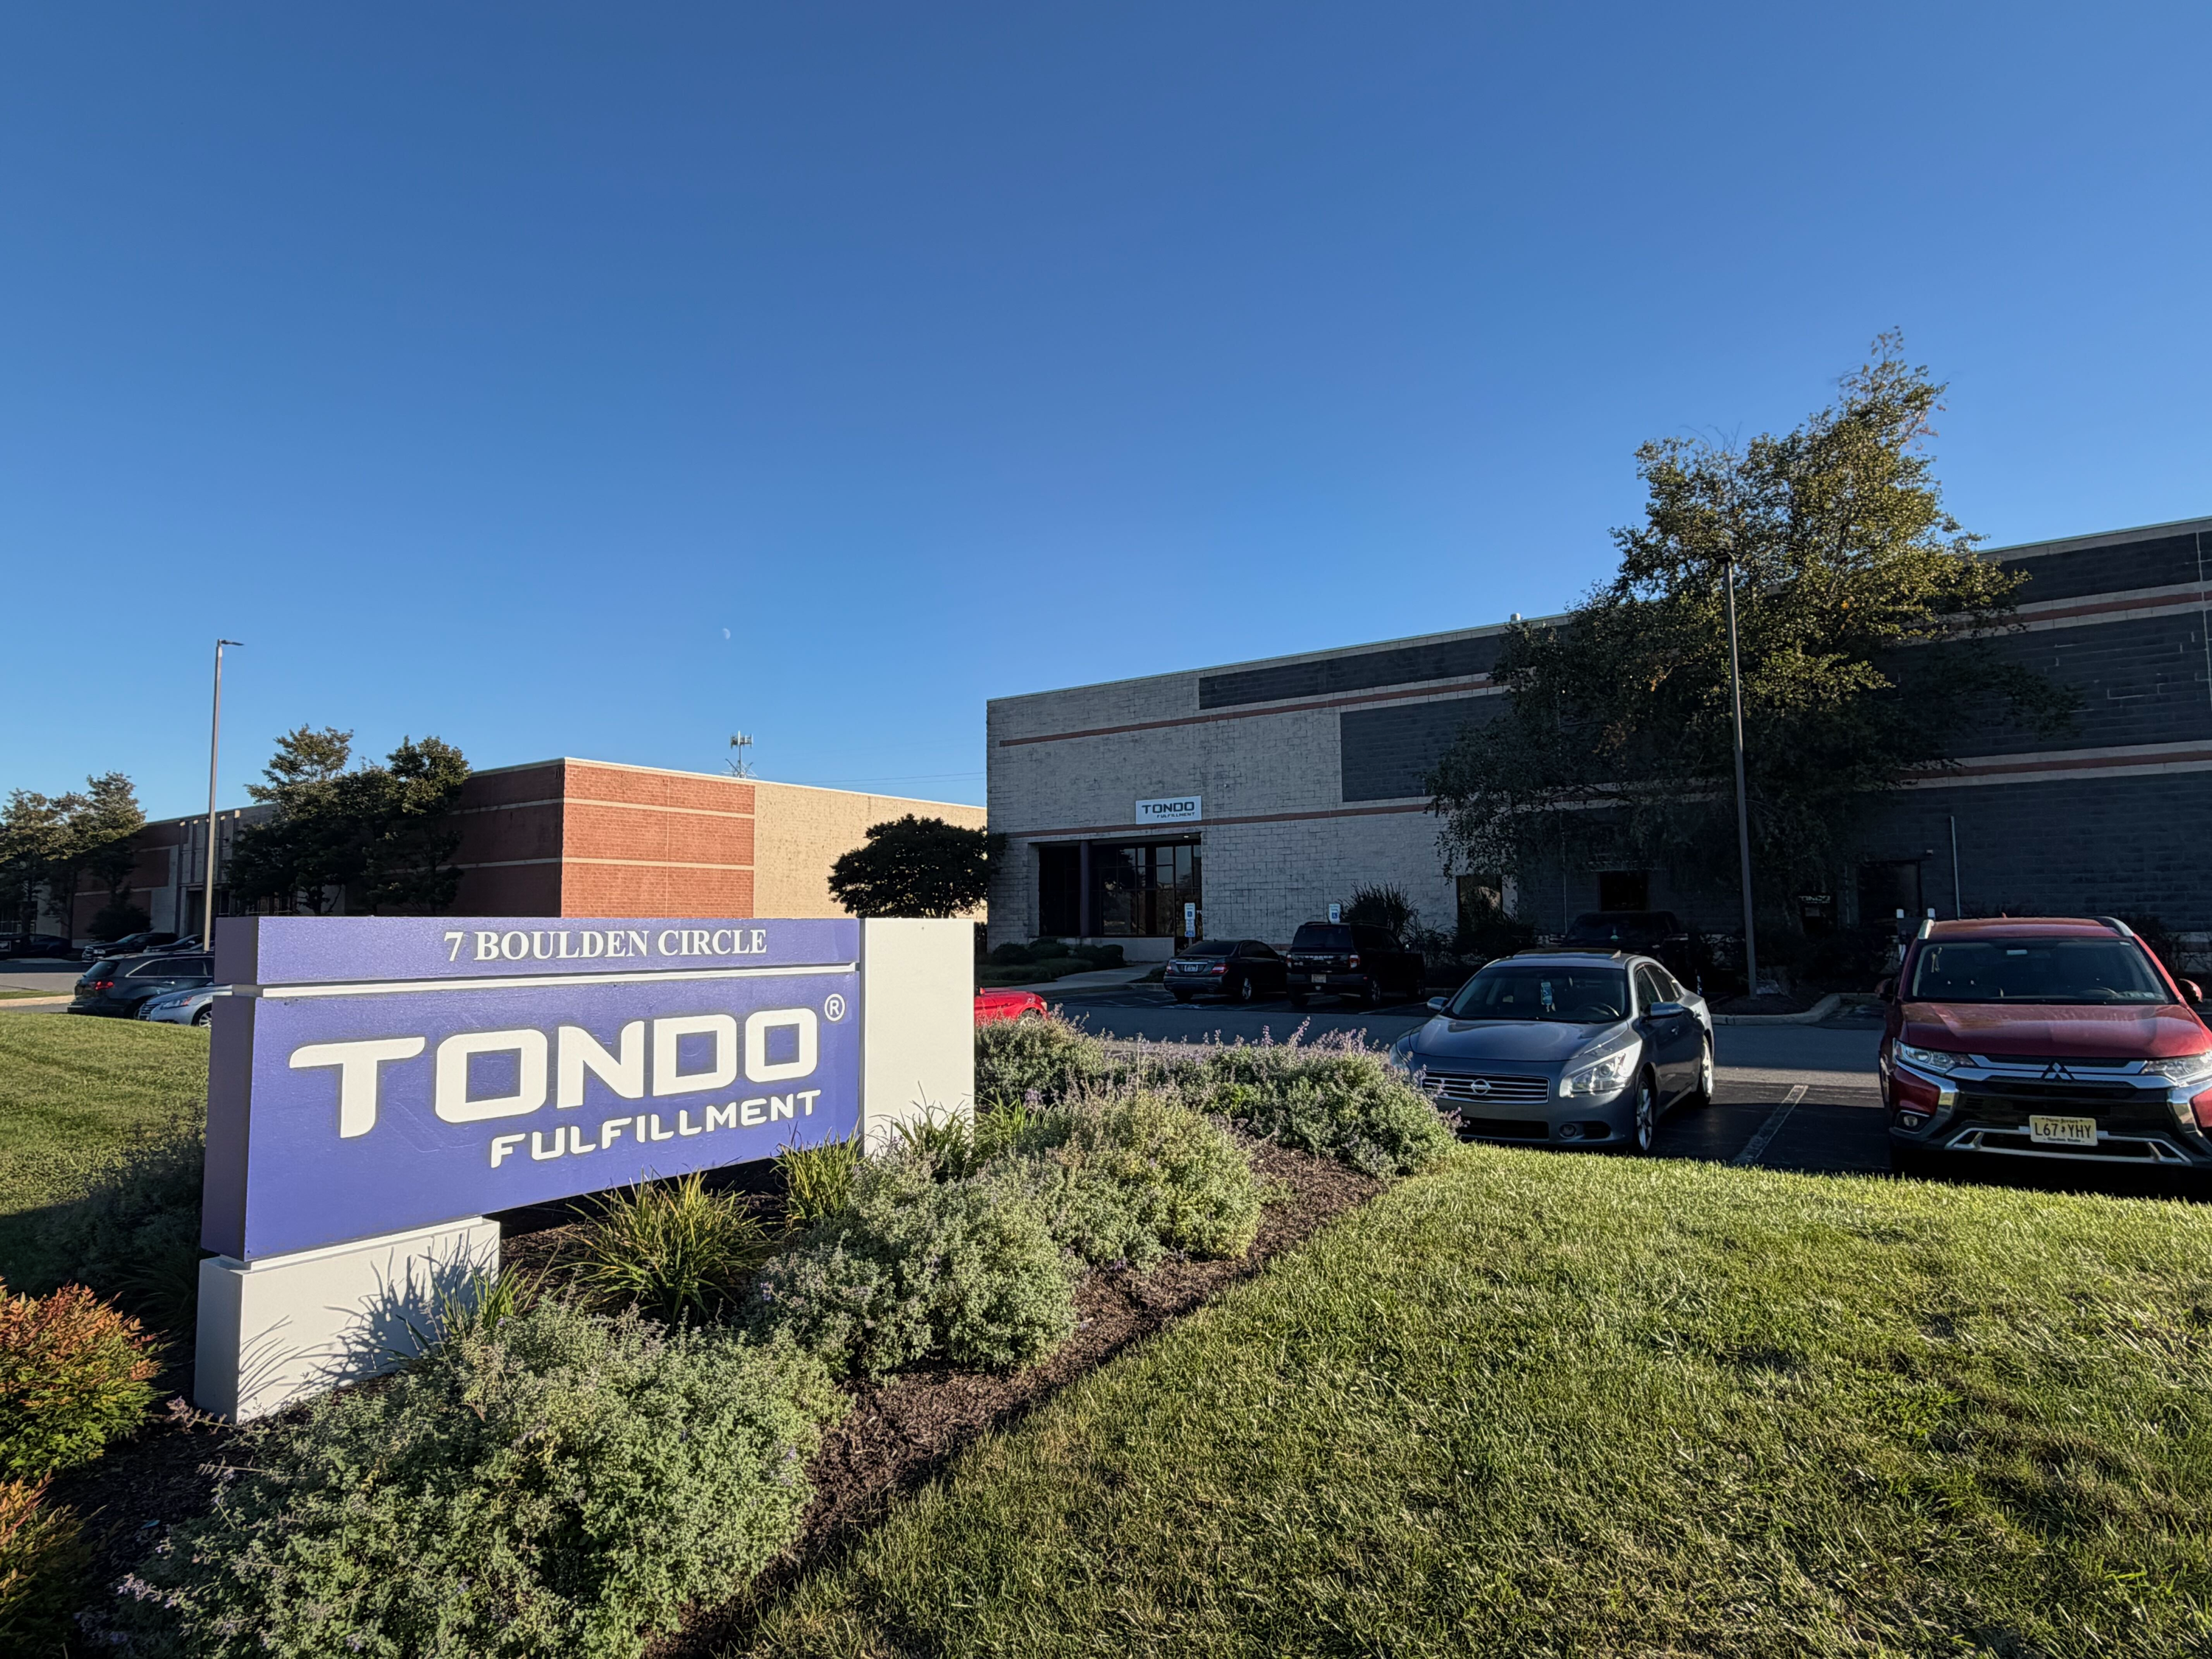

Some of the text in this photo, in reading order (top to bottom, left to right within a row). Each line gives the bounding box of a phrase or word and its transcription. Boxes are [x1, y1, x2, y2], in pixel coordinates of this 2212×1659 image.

[1141, 801, 1194, 814] TONDO
[443, 929, 768, 961] 7 BOULDEN CIRCLE
[289, 1008, 818, 1138] TONDO
[490, 1089, 821, 1169] FULFILLMENT
[2034, 1122, 2091, 1138] L67 YHY
